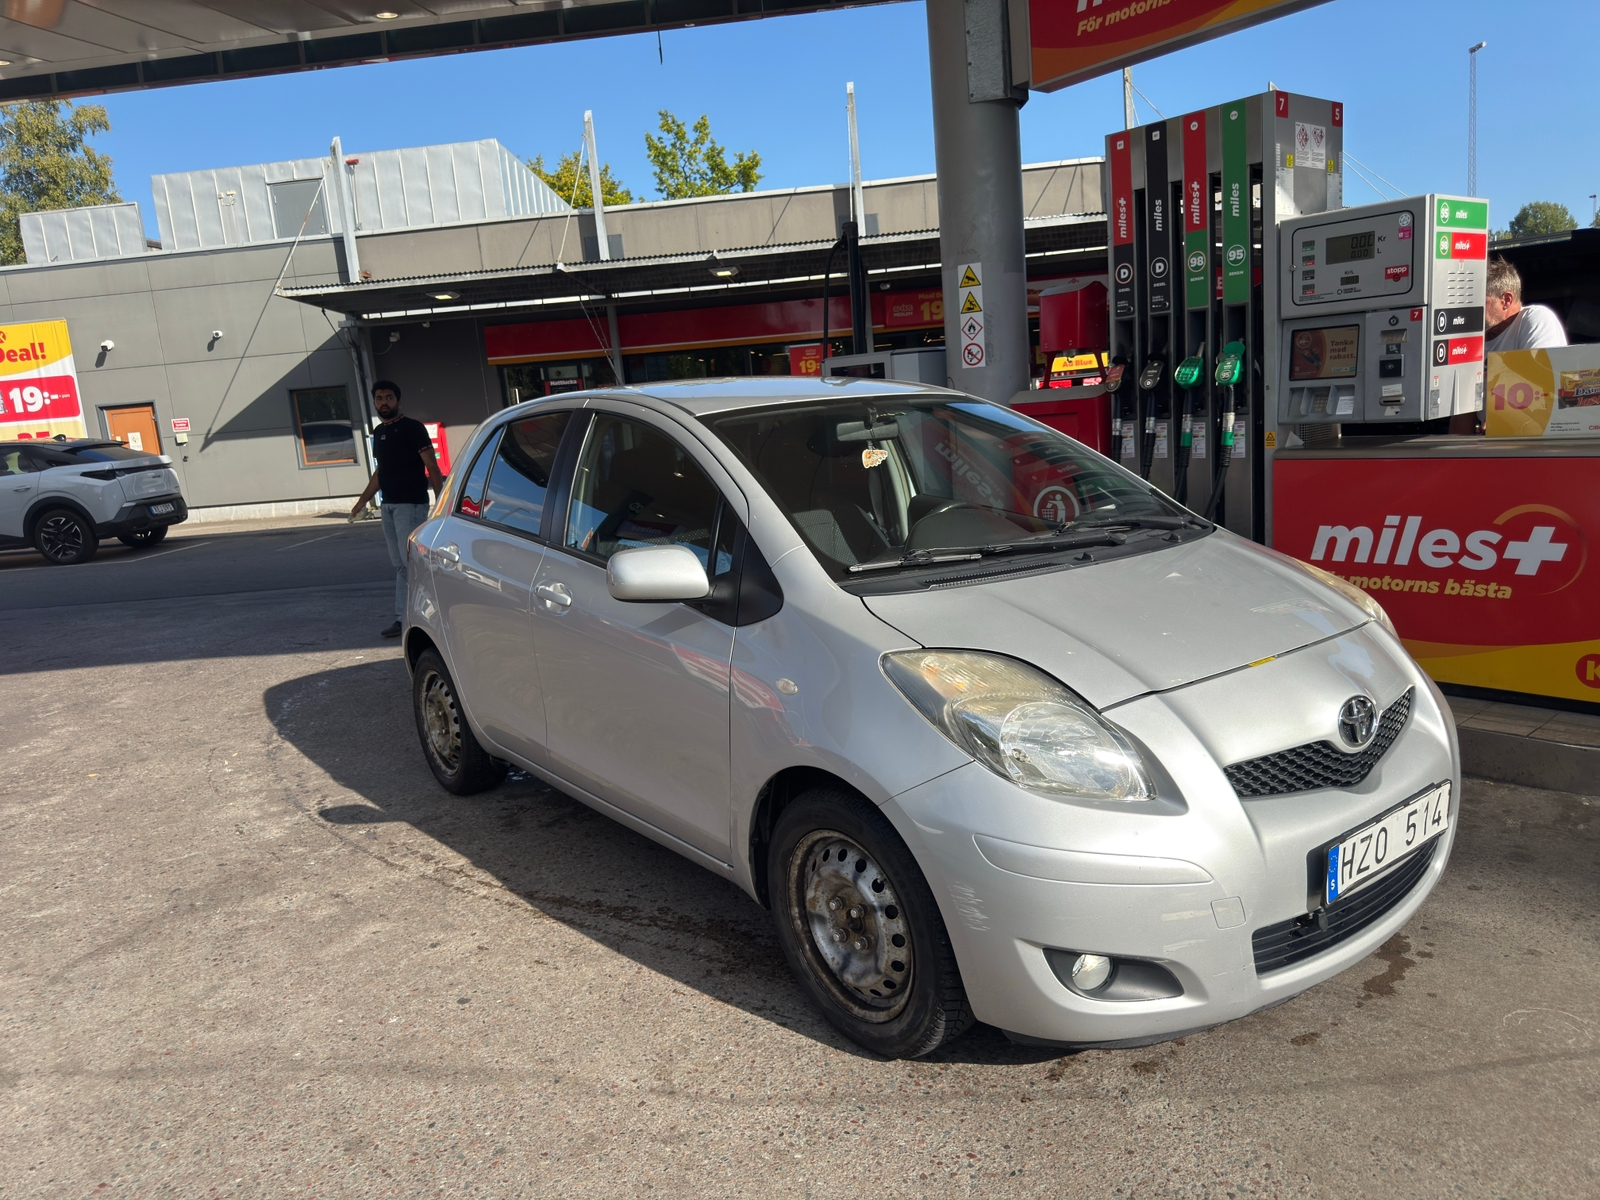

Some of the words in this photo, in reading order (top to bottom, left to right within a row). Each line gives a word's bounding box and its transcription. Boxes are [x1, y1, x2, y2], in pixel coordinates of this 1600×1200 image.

[1076, 15, 1103, 37] För
[1279, 98, 1285, 111] 7
[1335, 108, 1340, 121] 5
[1190, 181, 1200, 225] miles+
[1230, 183, 1240, 217] miles
[1118, 197, 1127, 239] miles+
[1153, 199, 1163, 232] miles
[1455, 210, 1468, 219] miles
[1228, 249, 1244, 261] 95
[1155, 262, 1164, 273] D
[1190, 256, 1204, 268] 98
[1120, 268, 1129, 279] D
[1386, 266, 1407, 275] stopp
[918, 292, 935, 300] Meal
[893, 303, 914, 312] extra
[1440, 316, 1445, 327] D
[1330, 339, 1354, 347] Tanka
[1074, 358, 1093, 367] Blue
[1329, 353, 1356, 361] rabatt.
[1310, 515, 1568, 576] miles+
[1347, 573, 1439, 595] motorns
[1444, 578, 1513, 600] bästa
[1341, 826, 1388, 885] HZO
[1405, 792, 1442, 846] 514
[1330, 879, 1336, 891] S
